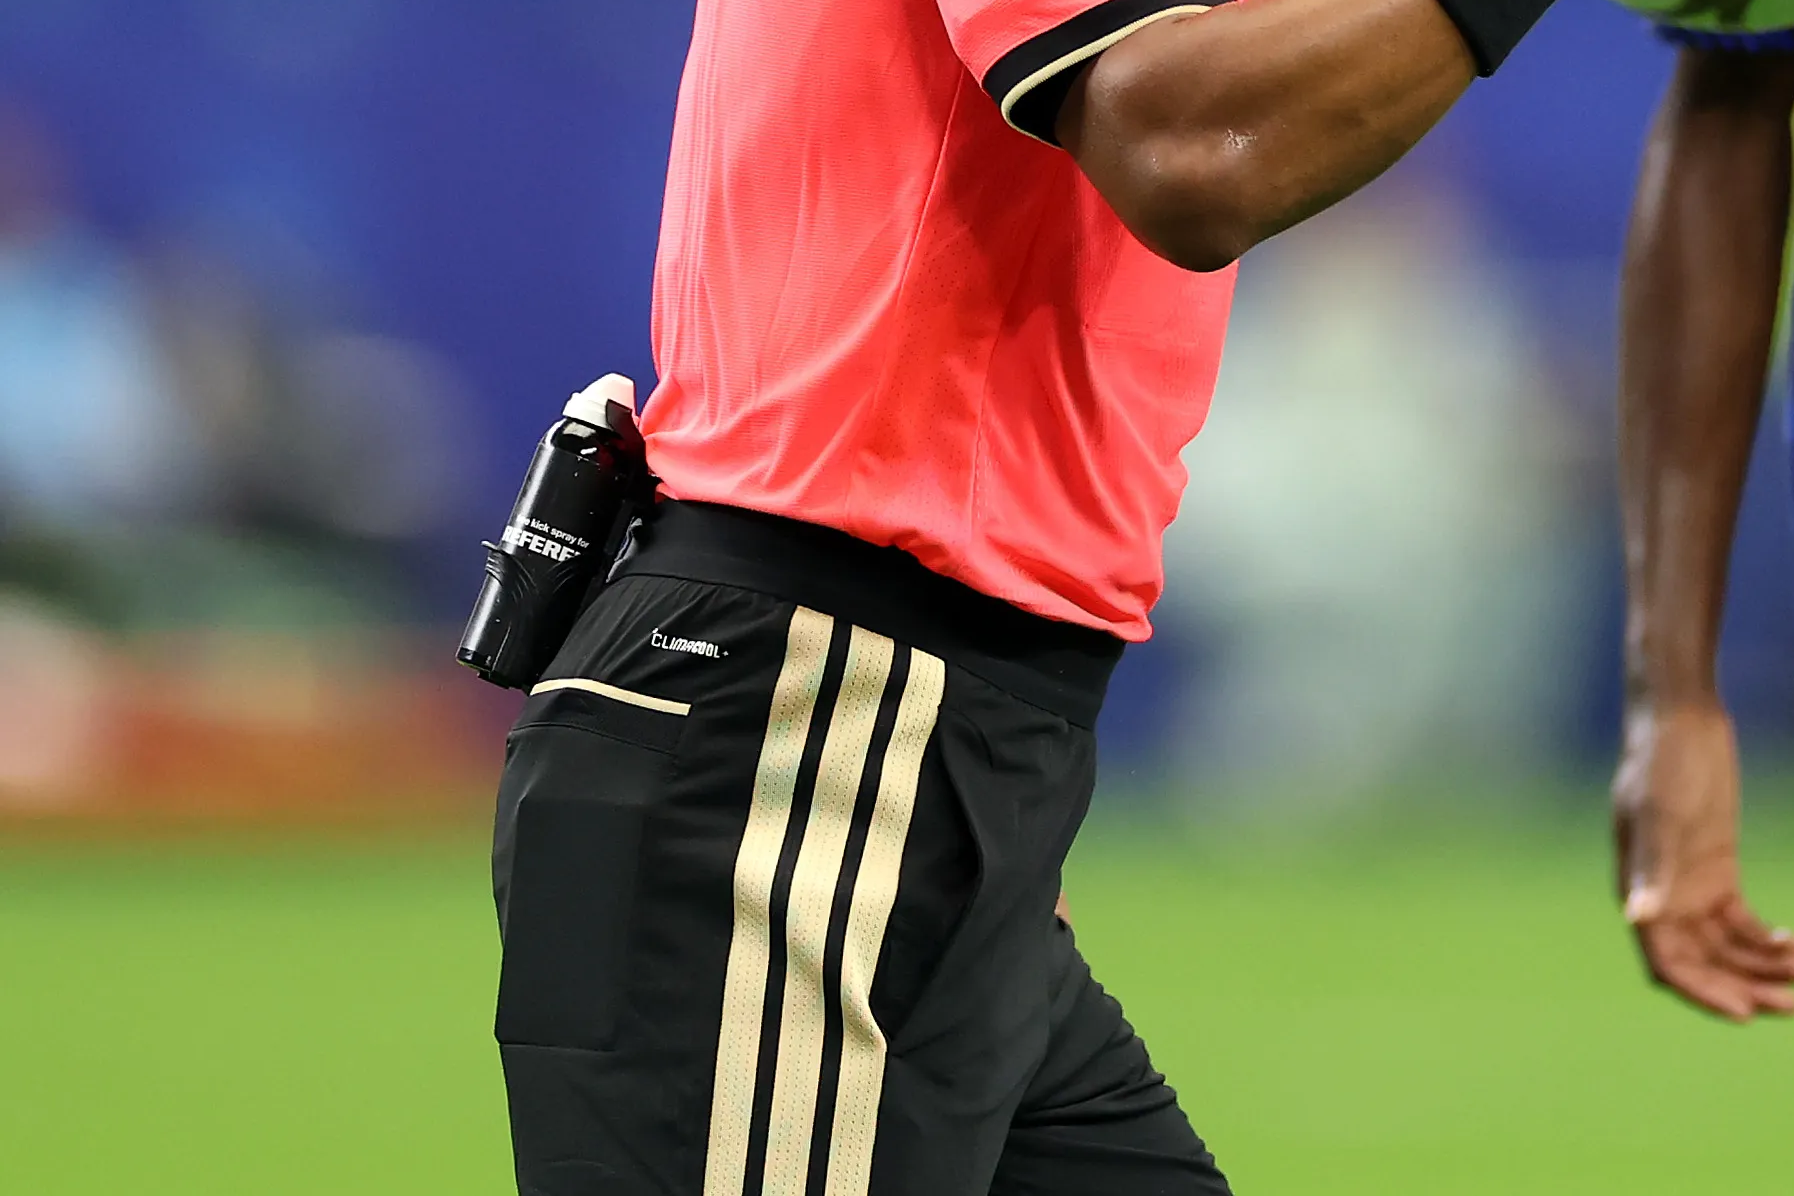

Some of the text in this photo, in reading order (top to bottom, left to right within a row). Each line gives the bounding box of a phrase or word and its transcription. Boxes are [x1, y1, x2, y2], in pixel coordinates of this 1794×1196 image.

[502, 525, 582, 562] REFERE
[530, 517, 550, 533] kick
[550, 527, 577, 545] spray
[577, 537, 590, 549] for
